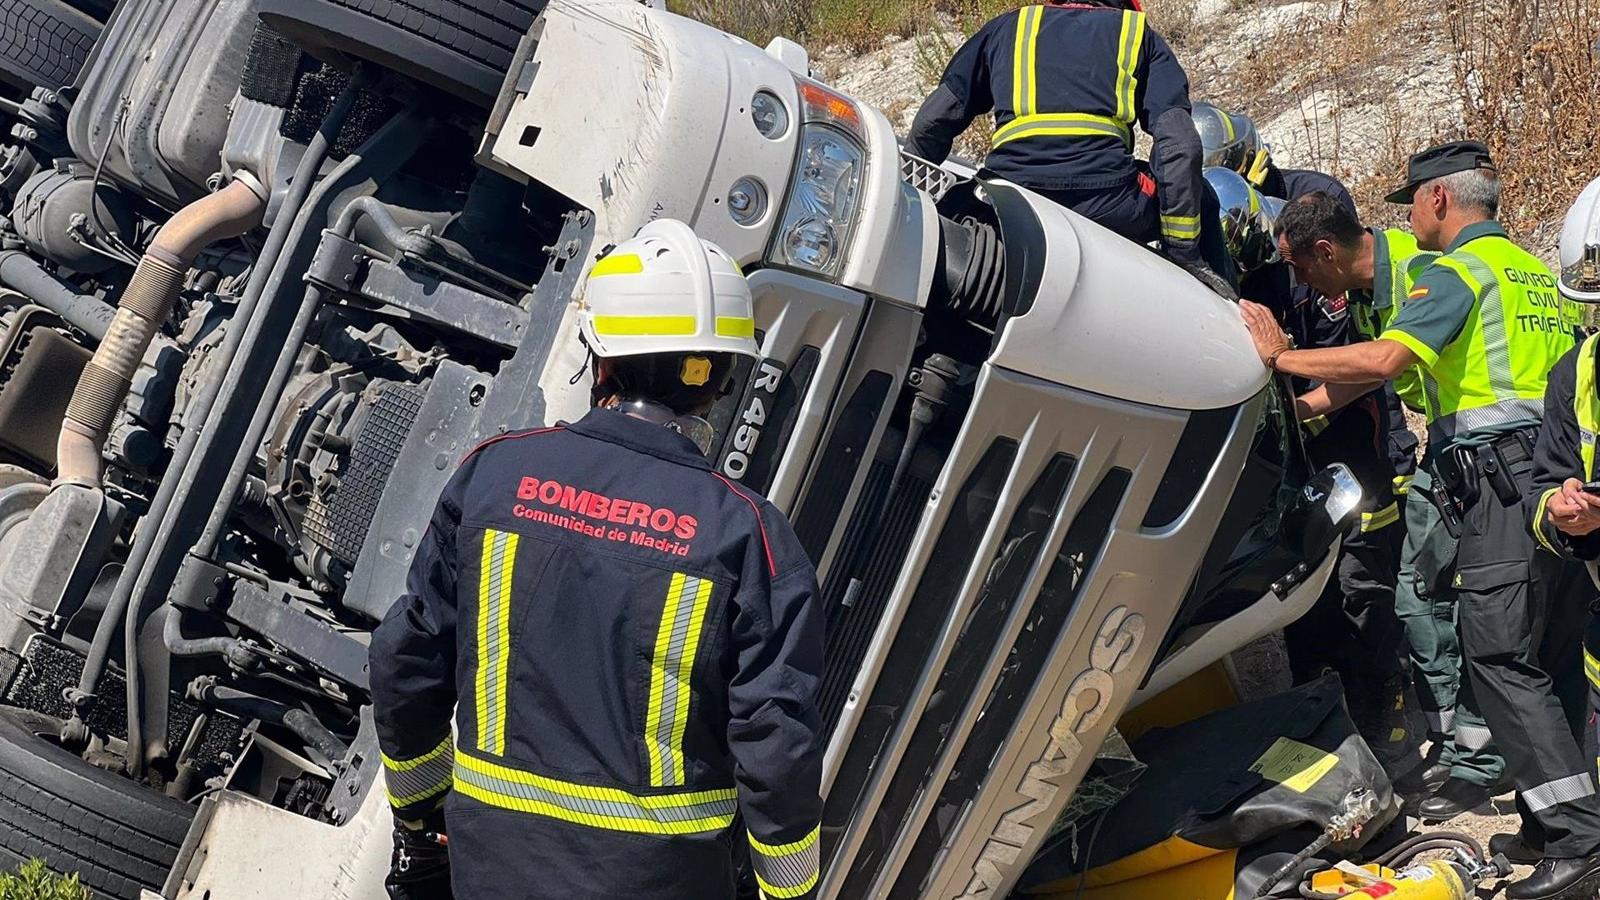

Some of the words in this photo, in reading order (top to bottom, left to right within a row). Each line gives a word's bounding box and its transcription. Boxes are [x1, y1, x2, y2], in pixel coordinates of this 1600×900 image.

[1527, 290, 1559, 308] CIVIL
[754, 363, 783, 393] R
[723, 397, 766, 480] 450
[512, 504, 606, 539] Comunidad
[607, 527, 627, 542] de
[630, 530, 690, 557] Madrid
[516, 476, 698, 539] BOMBEROS
[951, 603, 1147, 900] SCANIA
